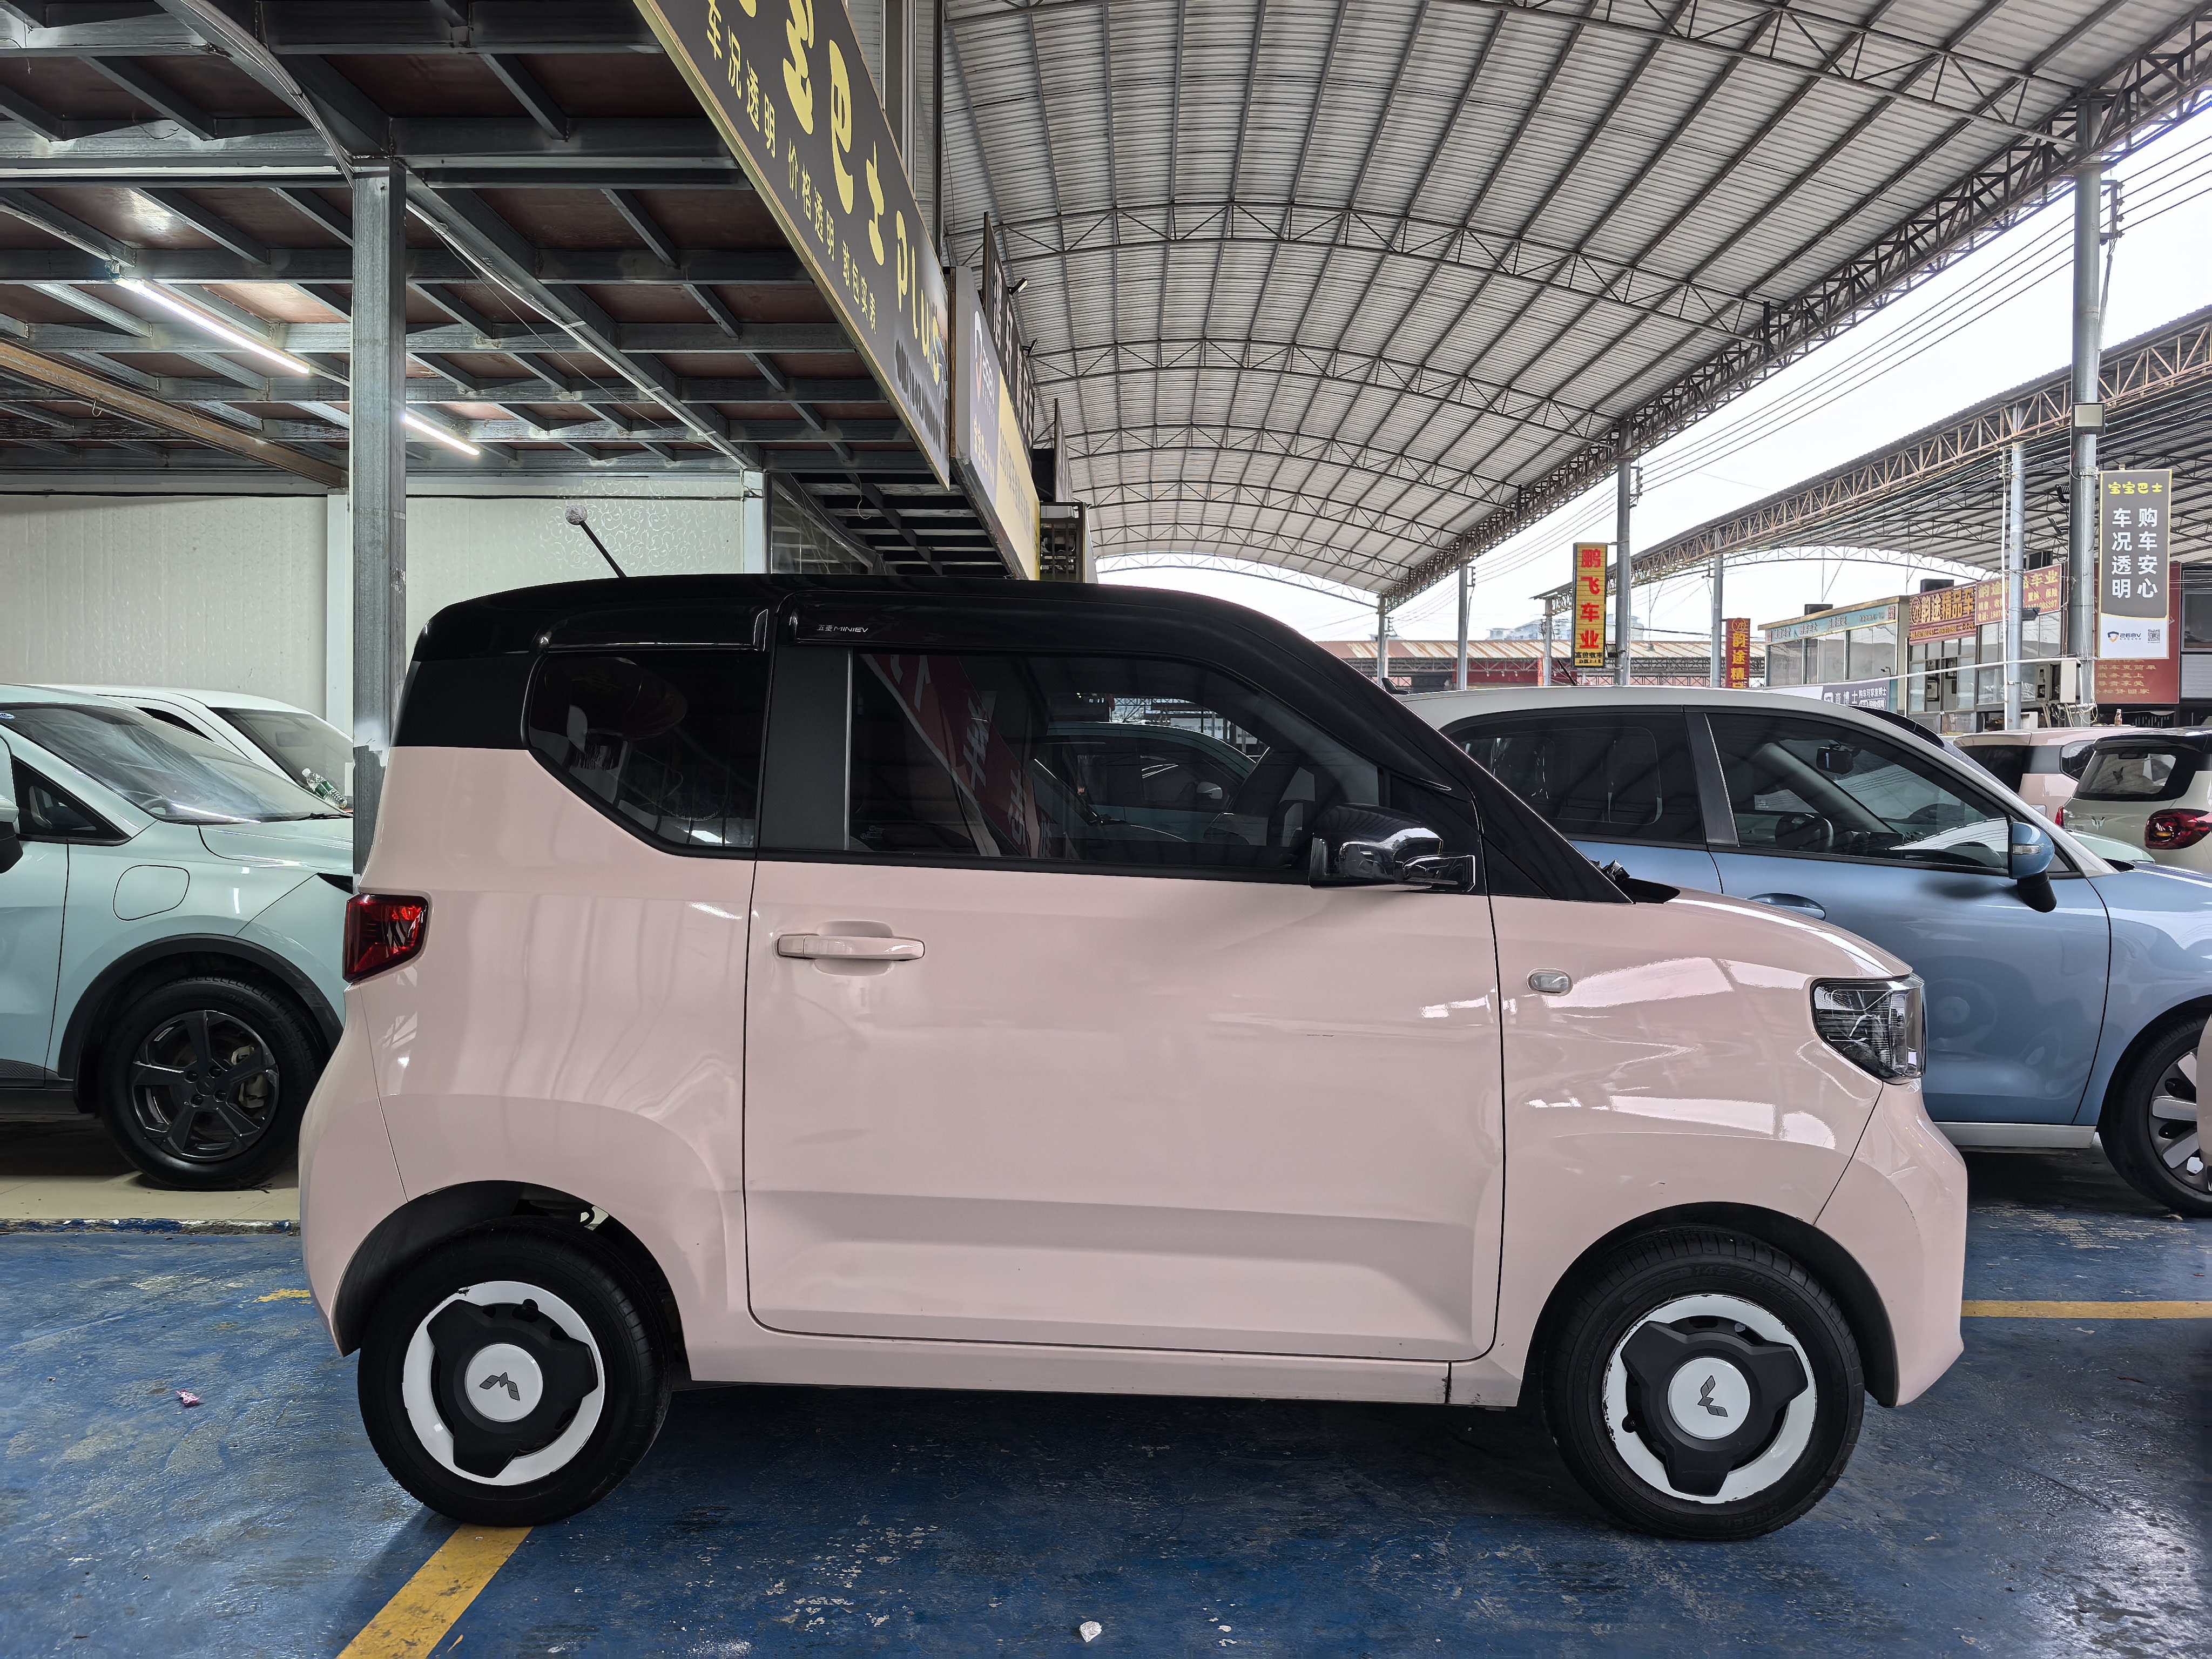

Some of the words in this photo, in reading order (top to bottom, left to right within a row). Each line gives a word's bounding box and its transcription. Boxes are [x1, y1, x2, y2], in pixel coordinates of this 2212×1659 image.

[706, 0, 776, 159] 车况透明
[788, 137, 833, 261] 价格透明
[2108, 481, 2163, 495] 宝宝巴士
[1580, 548, 1602, 649] 鹏飞车业
[2111, 507, 2133, 599] 车况透明
[2137, 507, 2159, 598] 购车安心
